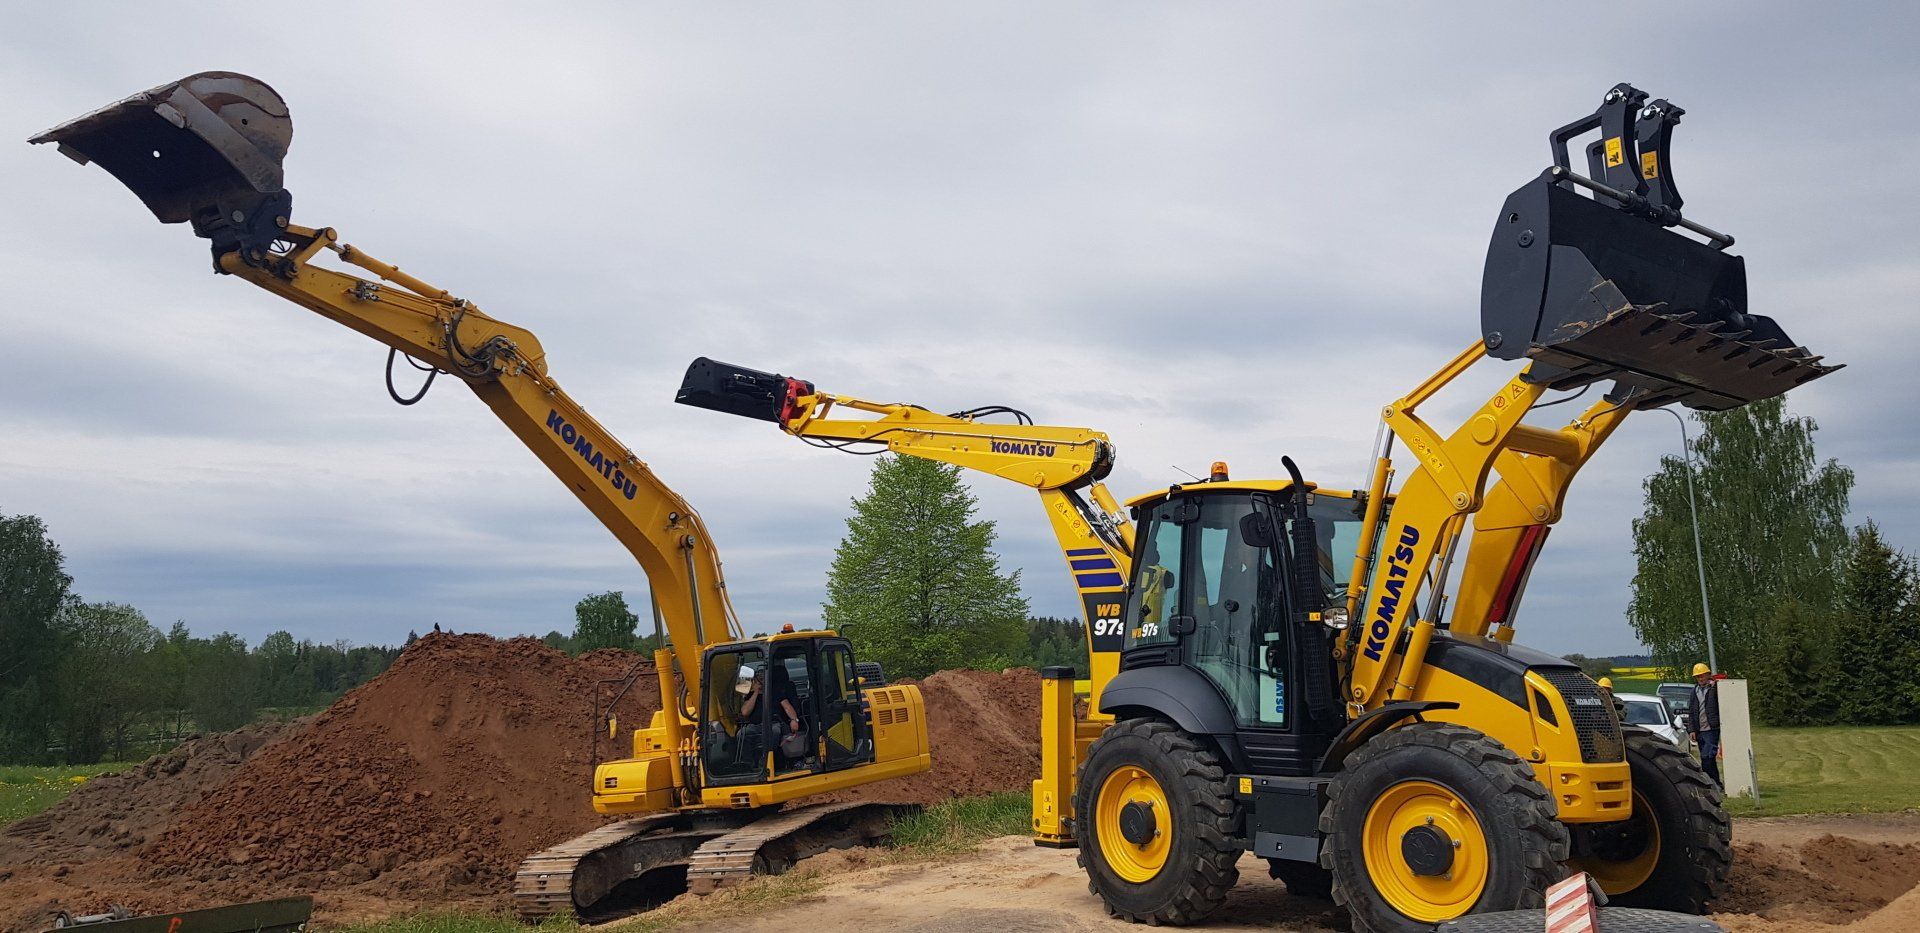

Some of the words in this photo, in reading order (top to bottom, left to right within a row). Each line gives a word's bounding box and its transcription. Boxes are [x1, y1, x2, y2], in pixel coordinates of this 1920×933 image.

[546, 409, 637, 500] KOMATSU
[991, 441, 1056, 457] KOMATSU
[1364, 525, 1420, 662] KOMATSU
[1096, 604, 1120, 616] WB
[1575, 697, 1602, 706] KOMATSU
